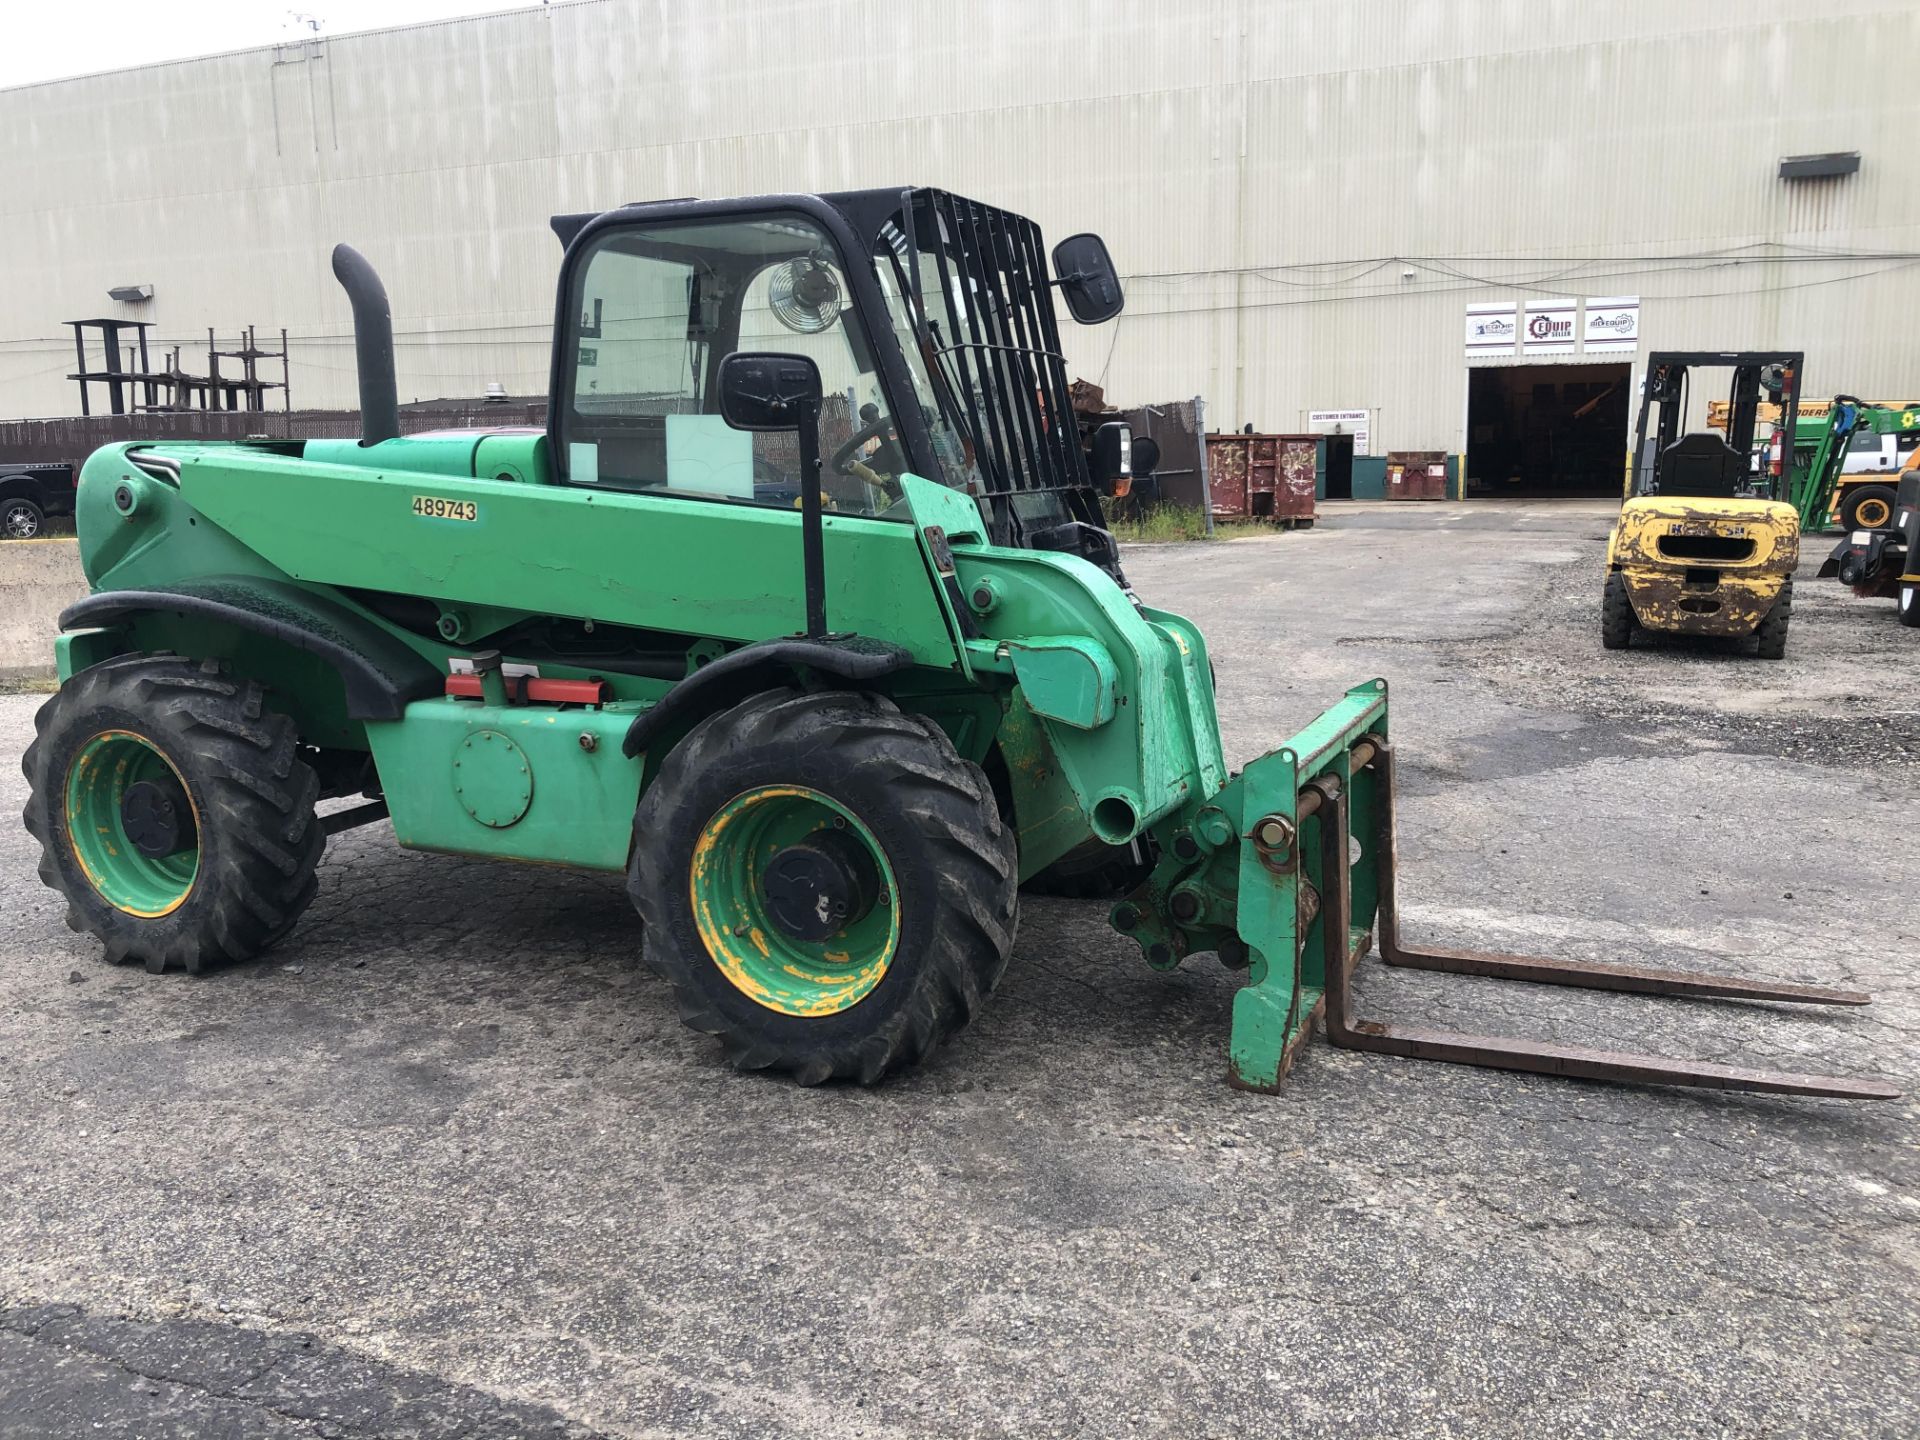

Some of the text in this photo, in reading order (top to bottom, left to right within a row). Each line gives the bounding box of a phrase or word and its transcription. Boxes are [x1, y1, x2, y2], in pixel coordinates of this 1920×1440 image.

[1538, 321, 1572, 333] EQUIP
[1605, 319, 1628, 327] EQUIP
[412, 497, 476, 521] 489743
